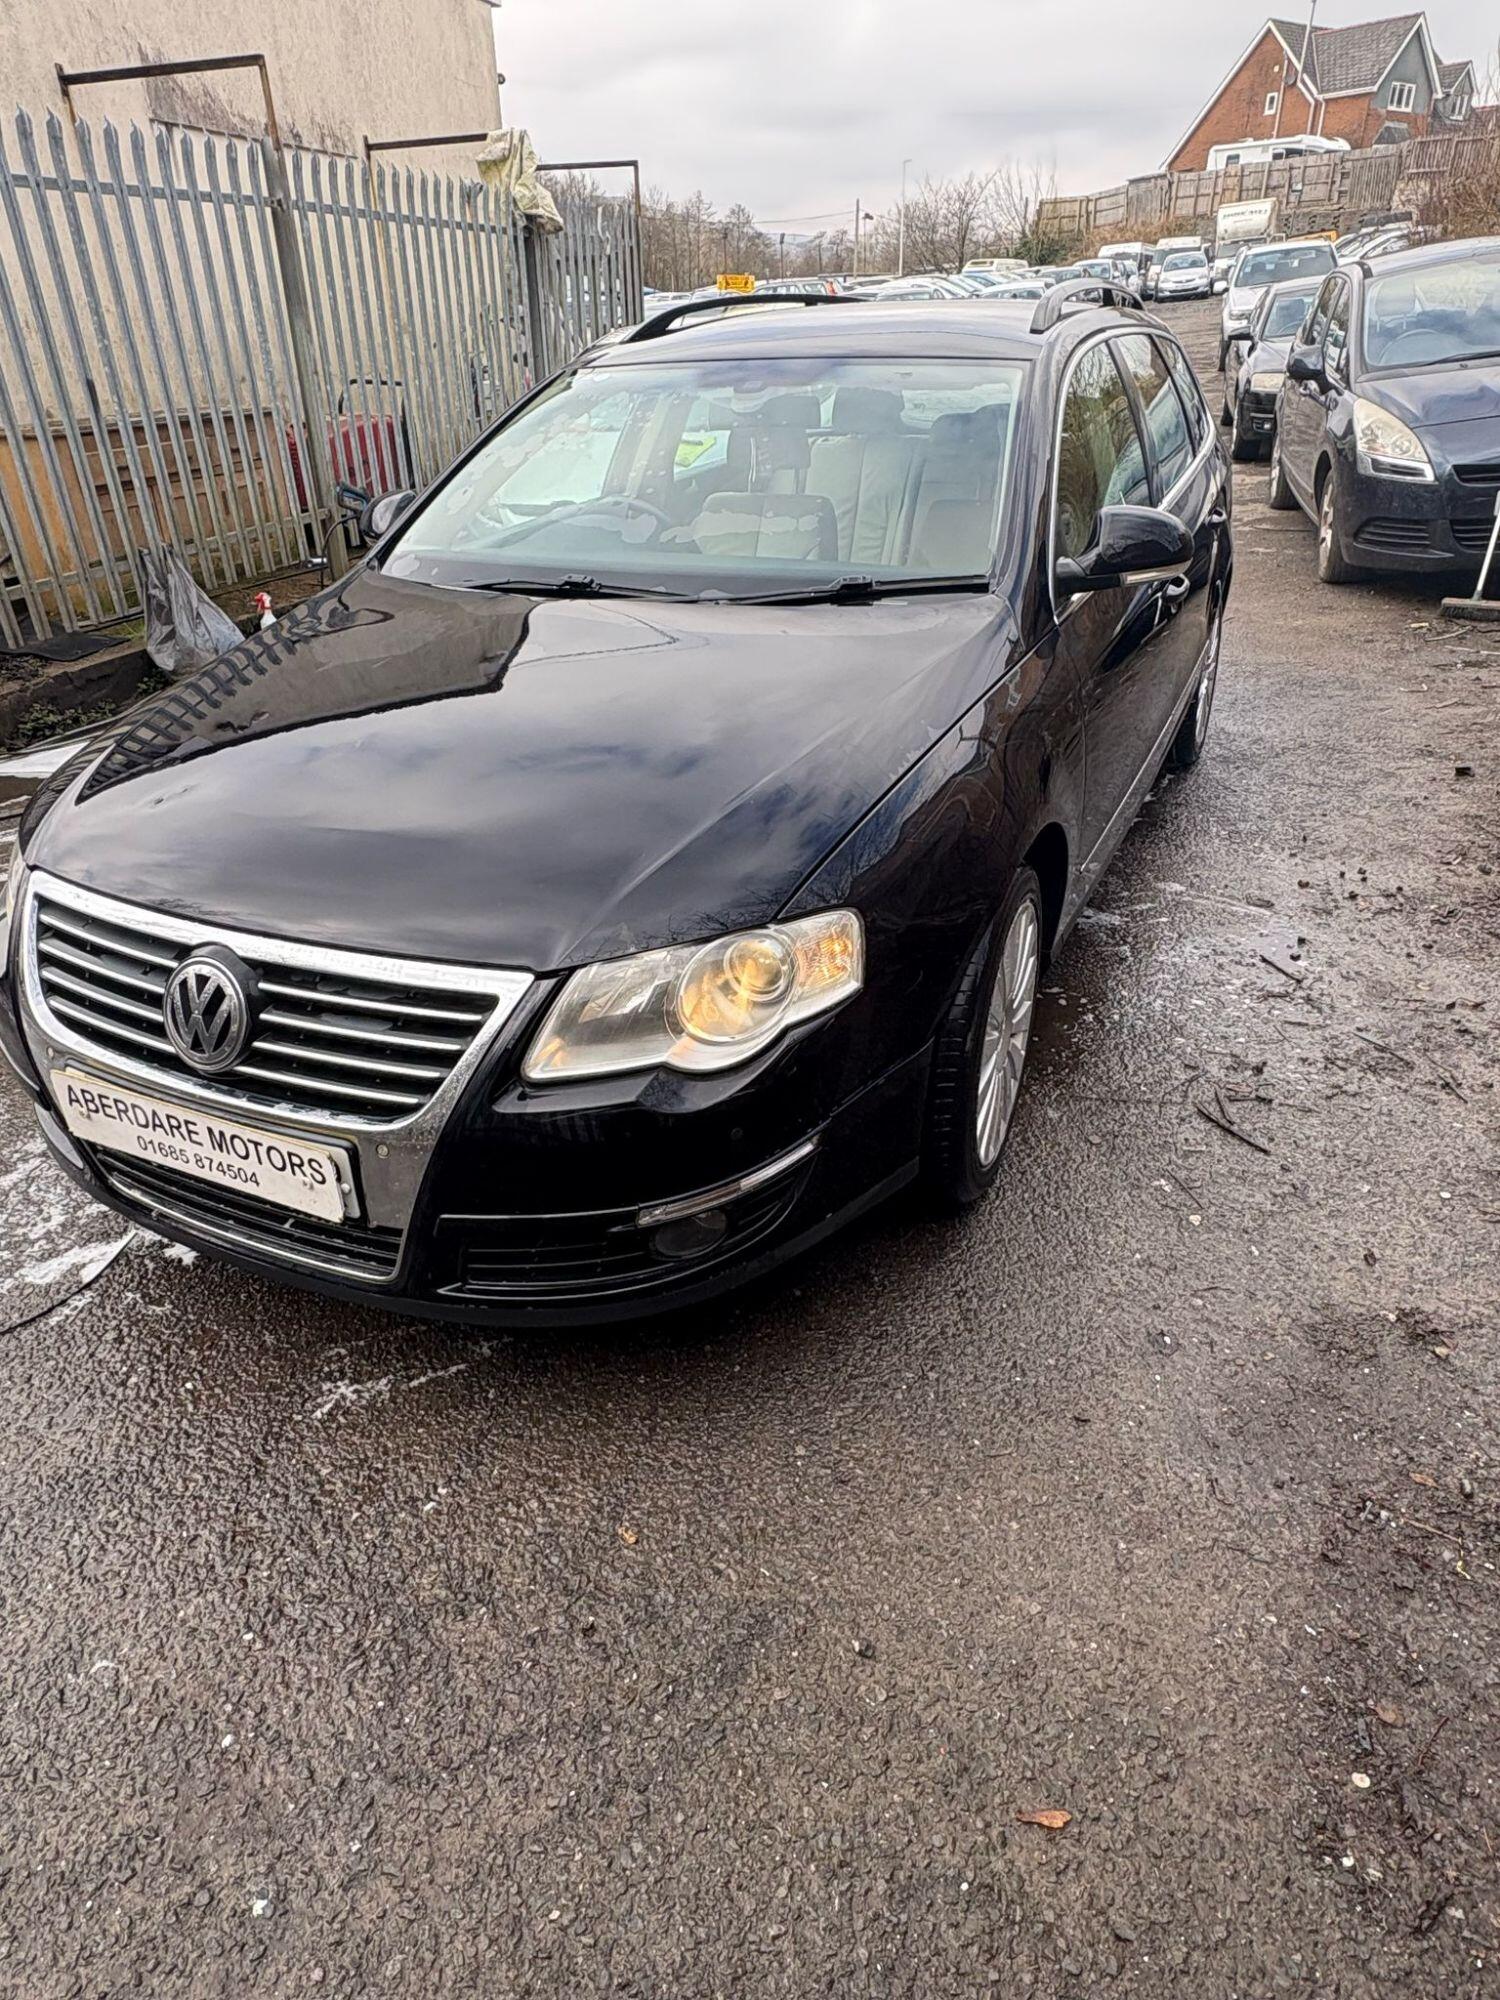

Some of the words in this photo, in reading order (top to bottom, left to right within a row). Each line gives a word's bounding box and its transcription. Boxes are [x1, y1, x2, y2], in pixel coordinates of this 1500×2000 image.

[67, 1084, 204, 1147] ABERDARE
[206, 1126, 327, 1185] MOTORS
[136, 1135, 190, 1164] 01685
[193, 1153, 260, 1187] 874504
